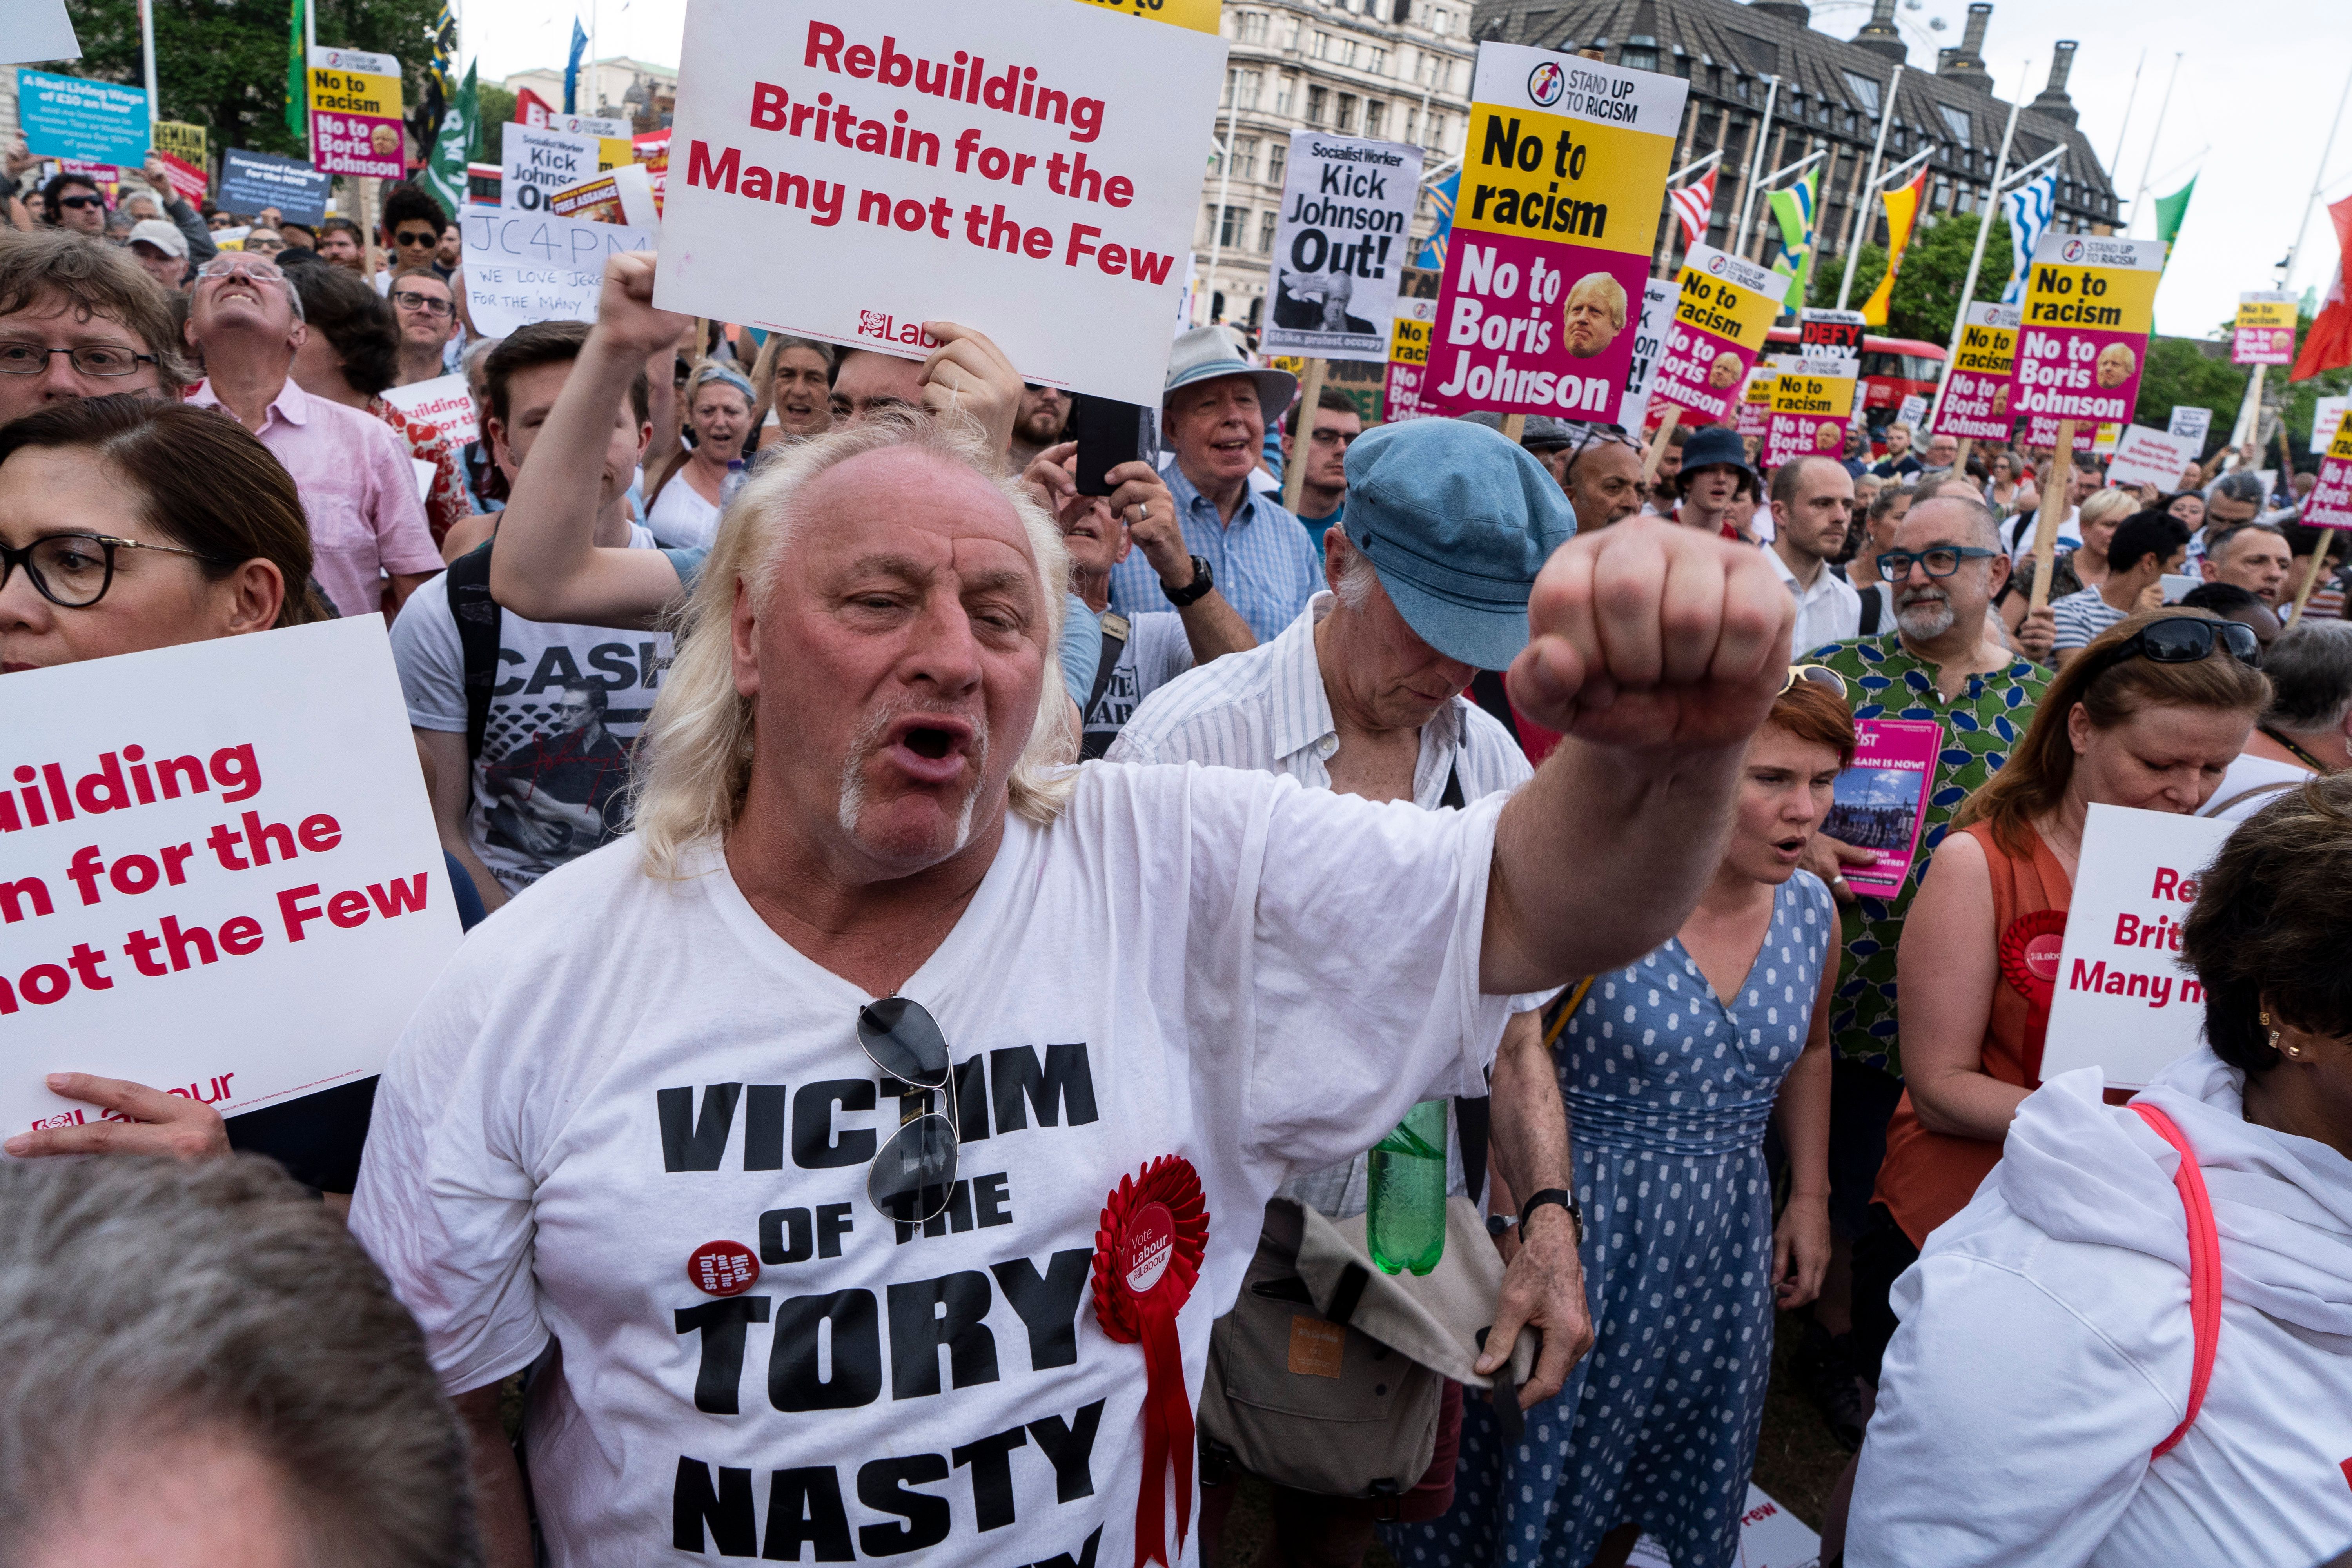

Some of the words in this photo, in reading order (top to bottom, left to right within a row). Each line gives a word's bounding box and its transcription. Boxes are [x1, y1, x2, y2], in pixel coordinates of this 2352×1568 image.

[315, 70, 340, 89] No
[346, 75, 365, 93] to
[804, 20, 1105, 143] Rebuilding
[1569, 69, 1607, 95] STAND
[1611, 79, 1635, 100] UP
[316, 93, 380, 113] racism
[1566, 91, 1583, 112] TO
[1585, 95, 1639, 123] RACISM
[317, 114, 345, 135] No
[348, 119, 369, 138] to
[319, 133, 371, 156] Boris
[750, 80, 940, 167] Britain
[955, 128, 1037, 187] for
[1046, 152, 1135, 209] the
[1312, 142, 1363, 163] Socialist
[1363, 147, 1404, 167] Worker
[1481, 114, 1543, 172] No
[1555, 129, 1586, 181] to
[320, 152, 400, 176] Johnson
[530, 147, 576, 171] Kick
[1320, 163, 1387, 200] Kick
[554, 198, 575, 214] FREE
[577, 185, 618, 207] ASSANGE
[686, 139, 846, 227] Many
[857, 188, 954, 240] not
[964, 203, 1054, 260] the
[1064, 222, 1176, 287] Few
[1471, 181, 1607, 239] racism
[1287, 194, 1404, 234] Johnson
[1291, 228, 1392, 279] Out!
[2087, 242, 2118, 253] STAND
[2120, 244, 2134, 254] UP
[2087, 251, 2099, 261] TO
[2100, 252, 2137, 266] RACISM
[479, 269, 503, 283] WE
[518, 269, 558, 283] LOVE
[567, 271, 602, 287] JERE
[1457, 243, 1520, 299] No
[1528, 256, 1561, 305] to
[1737, 275, 1765, 292] RACISM
[1754, 270, 1765, 281] UP
[2036, 268, 2073, 294] No
[2081, 272, 2107, 296] to
[472, 291, 497, 306] FOR
[501, 296, 529, 308] THE
[1682, 272, 1711, 299] No
[1715, 285, 1737, 309] to
[1678, 299, 1742, 338] racism
[2031, 298, 2122, 325] racism
[1399, 321, 1422, 342] No
[1448, 296, 1552, 356] Boris
[1803, 322, 1860, 346] DEFY
[1965, 328, 1989, 347] No
[1993, 332, 2009, 350] to
[1396, 345, 1429, 362] raci
[1665, 326, 1689, 352] No
[1692, 336, 1715, 362] to
[2023, 331, 2061, 359] No
[2067, 335, 2096, 362] to
[1959, 351, 2013, 371] racism
[2018, 358, 2092, 389] Boris
[1391, 365, 1417, 387] No
[1437, 350, 1610, 413] Johnson
[1780, 376, 1802, 393] No
[1807, 379, 1823, 394] to
[1950, 374, 1975, 395] No
[1977, 377, 1996, 398] to
[1653, 374, 1726, 417] ohnson
[1777, 396, 1832, 412] racism
[1943, 392, 1990, 417] Boris
[2014, 385, 2126, 419] Johnson
[1771, 415, 1796, 434] No
[1798, 417, 1817, 436] to
[1937, 412, 2008, 439] Johnson
[1768, 432, 1813, 452] Boris
[2321, 462, 2342, 483] No
[2312, 481, 2350, 506] Boris
[1882, 758, 1893, 768] IS
[67, 841, 194, 907] for
[207, 810, 343, 871] the
[123, 914, 265, 977] the
[276, 871, 429, 943] Few
[2114, 913, 2184, 951] Brit
[2069, 958, 2172, 1007] Many
[657, 1041, 1100, 1173] VICTIM
[759, 1201, 854, 1265] OF
[880, 1171, 1013, 1246] THE
[1132, 1227, 1152, 1250] Vote
[1132, 1234, 1168, 1267] Labour
[699, 1253, 719, 1290] Tories
[717, 1255, 731, 1271] out
[730, 1254, 752, 1282] Kick
[1139, 1251, 1166, 1279] Labour
[721, 1273, 734, 1287] the
[673, 1246, 1094, 1415] TORY
[672, 1397, 1107, 1563] NASTY
